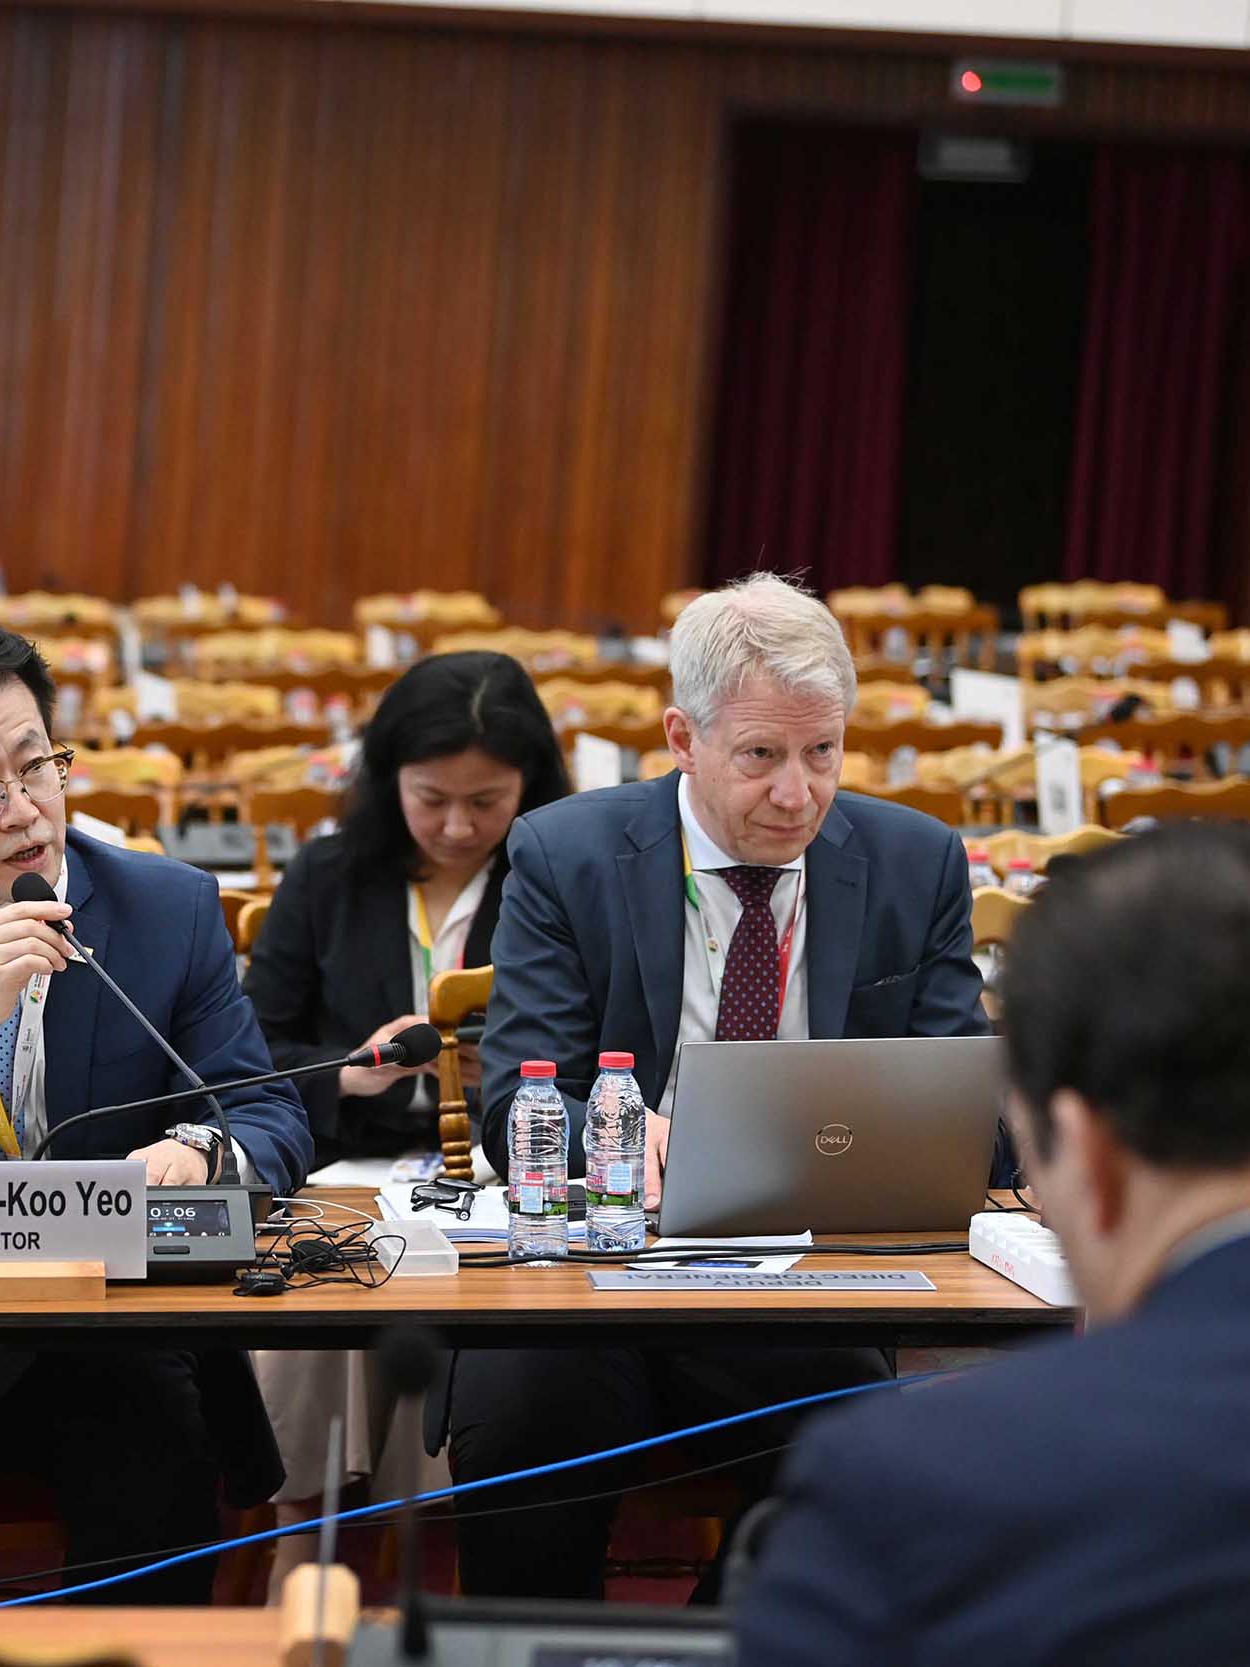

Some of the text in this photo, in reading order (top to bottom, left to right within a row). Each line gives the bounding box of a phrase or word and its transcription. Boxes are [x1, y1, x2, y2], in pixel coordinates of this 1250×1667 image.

[820, 1135, 848, 1145] DELL
[75, 1181, 133, 1217] Yeo
[150, 1207, 196, 1218] 0:06
[619, 1273, 907, 1281] DIRECTOR-GENERAL
